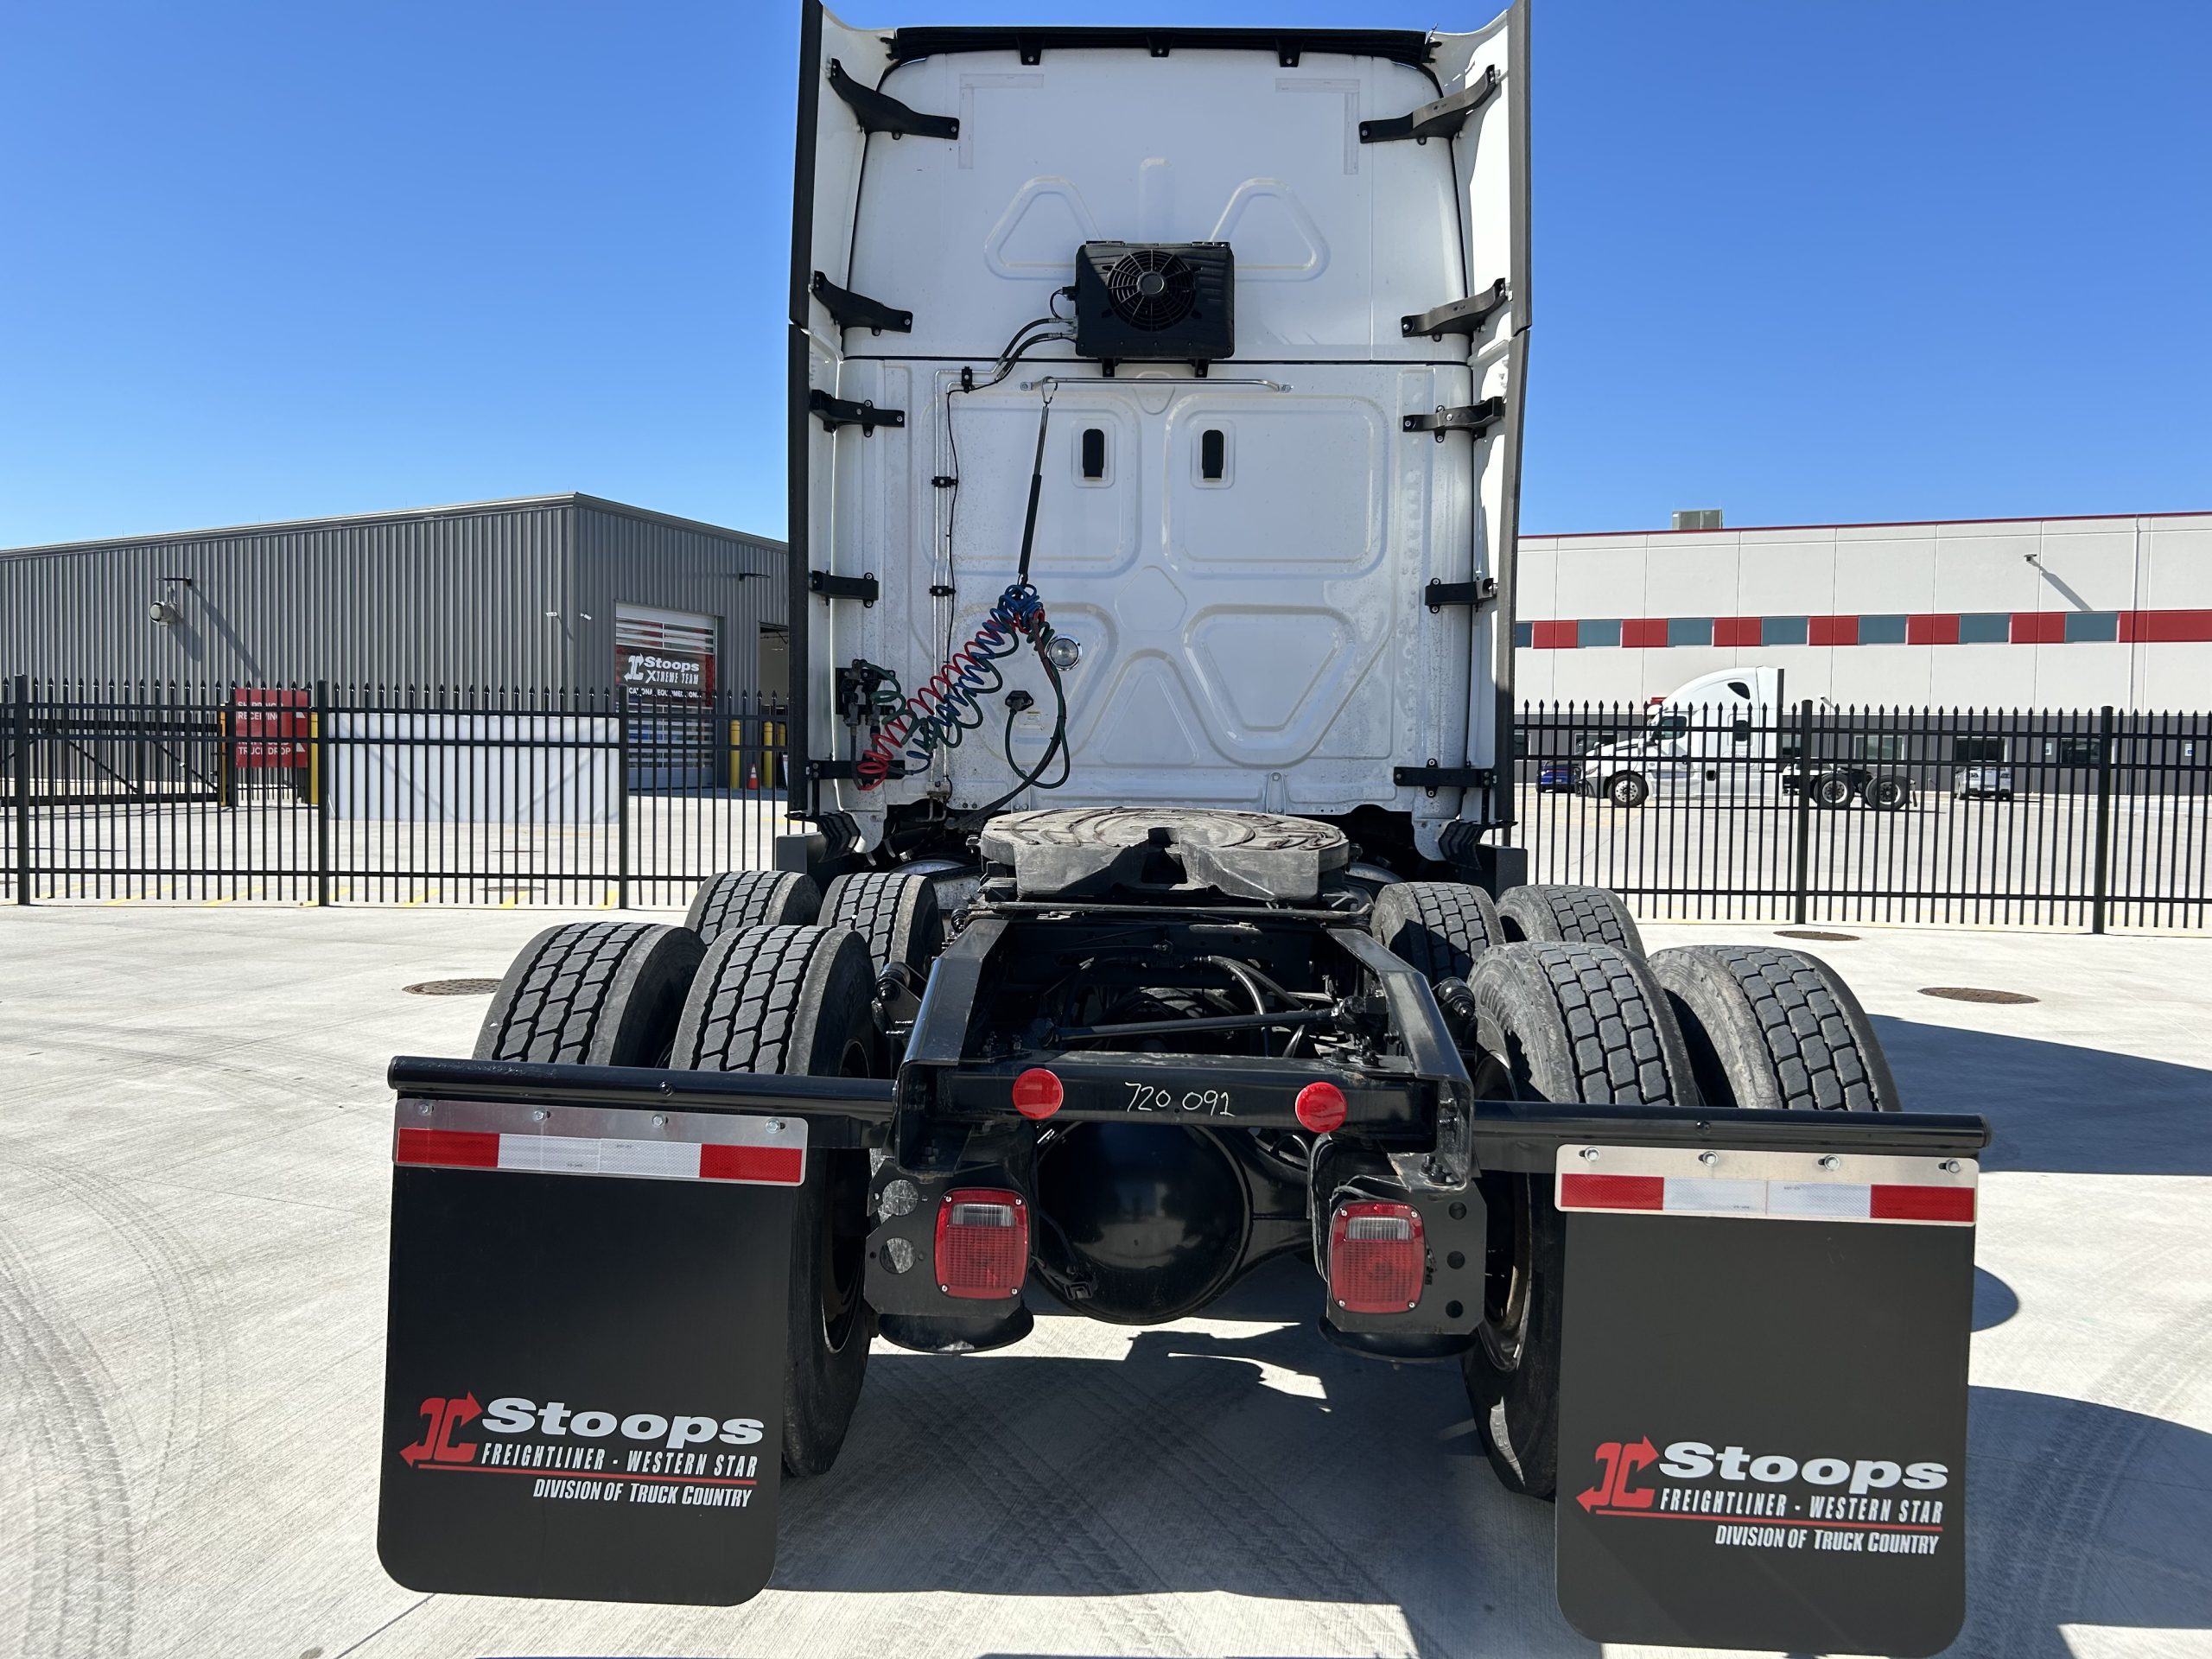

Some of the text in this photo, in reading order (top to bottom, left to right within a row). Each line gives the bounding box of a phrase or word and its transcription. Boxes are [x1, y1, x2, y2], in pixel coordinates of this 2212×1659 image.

[644, 656, 700, 672] Stoops
[645, 670, 699, 684] XTREME TEAM
[238, 711, 279, 721] RECEIIN
[1125, 1081, 1236, 1117] 720 091
[482, 1397, 765, 1449] Stoops
[481, 1442, 606, 1470] FREIGHTLINER
[626, 1450, 707, 1476] WESTERN
[714, 1454, 758, 1478] STAR
[1658, 1441, 1948, 1494] Stoops
[533, 1478, 752, 1508] DIVISION OF TRUCK COUNTRY
[1660, 1487, 1788, 1516] FREIGHTLINER
[1809, 1495, 1892, 1522] WESTERN
[1898, 1499, 1943, 1523] STAR
[1715, 1524, 1940, 1554] DIVISION OF TRUCK COUNTRY
